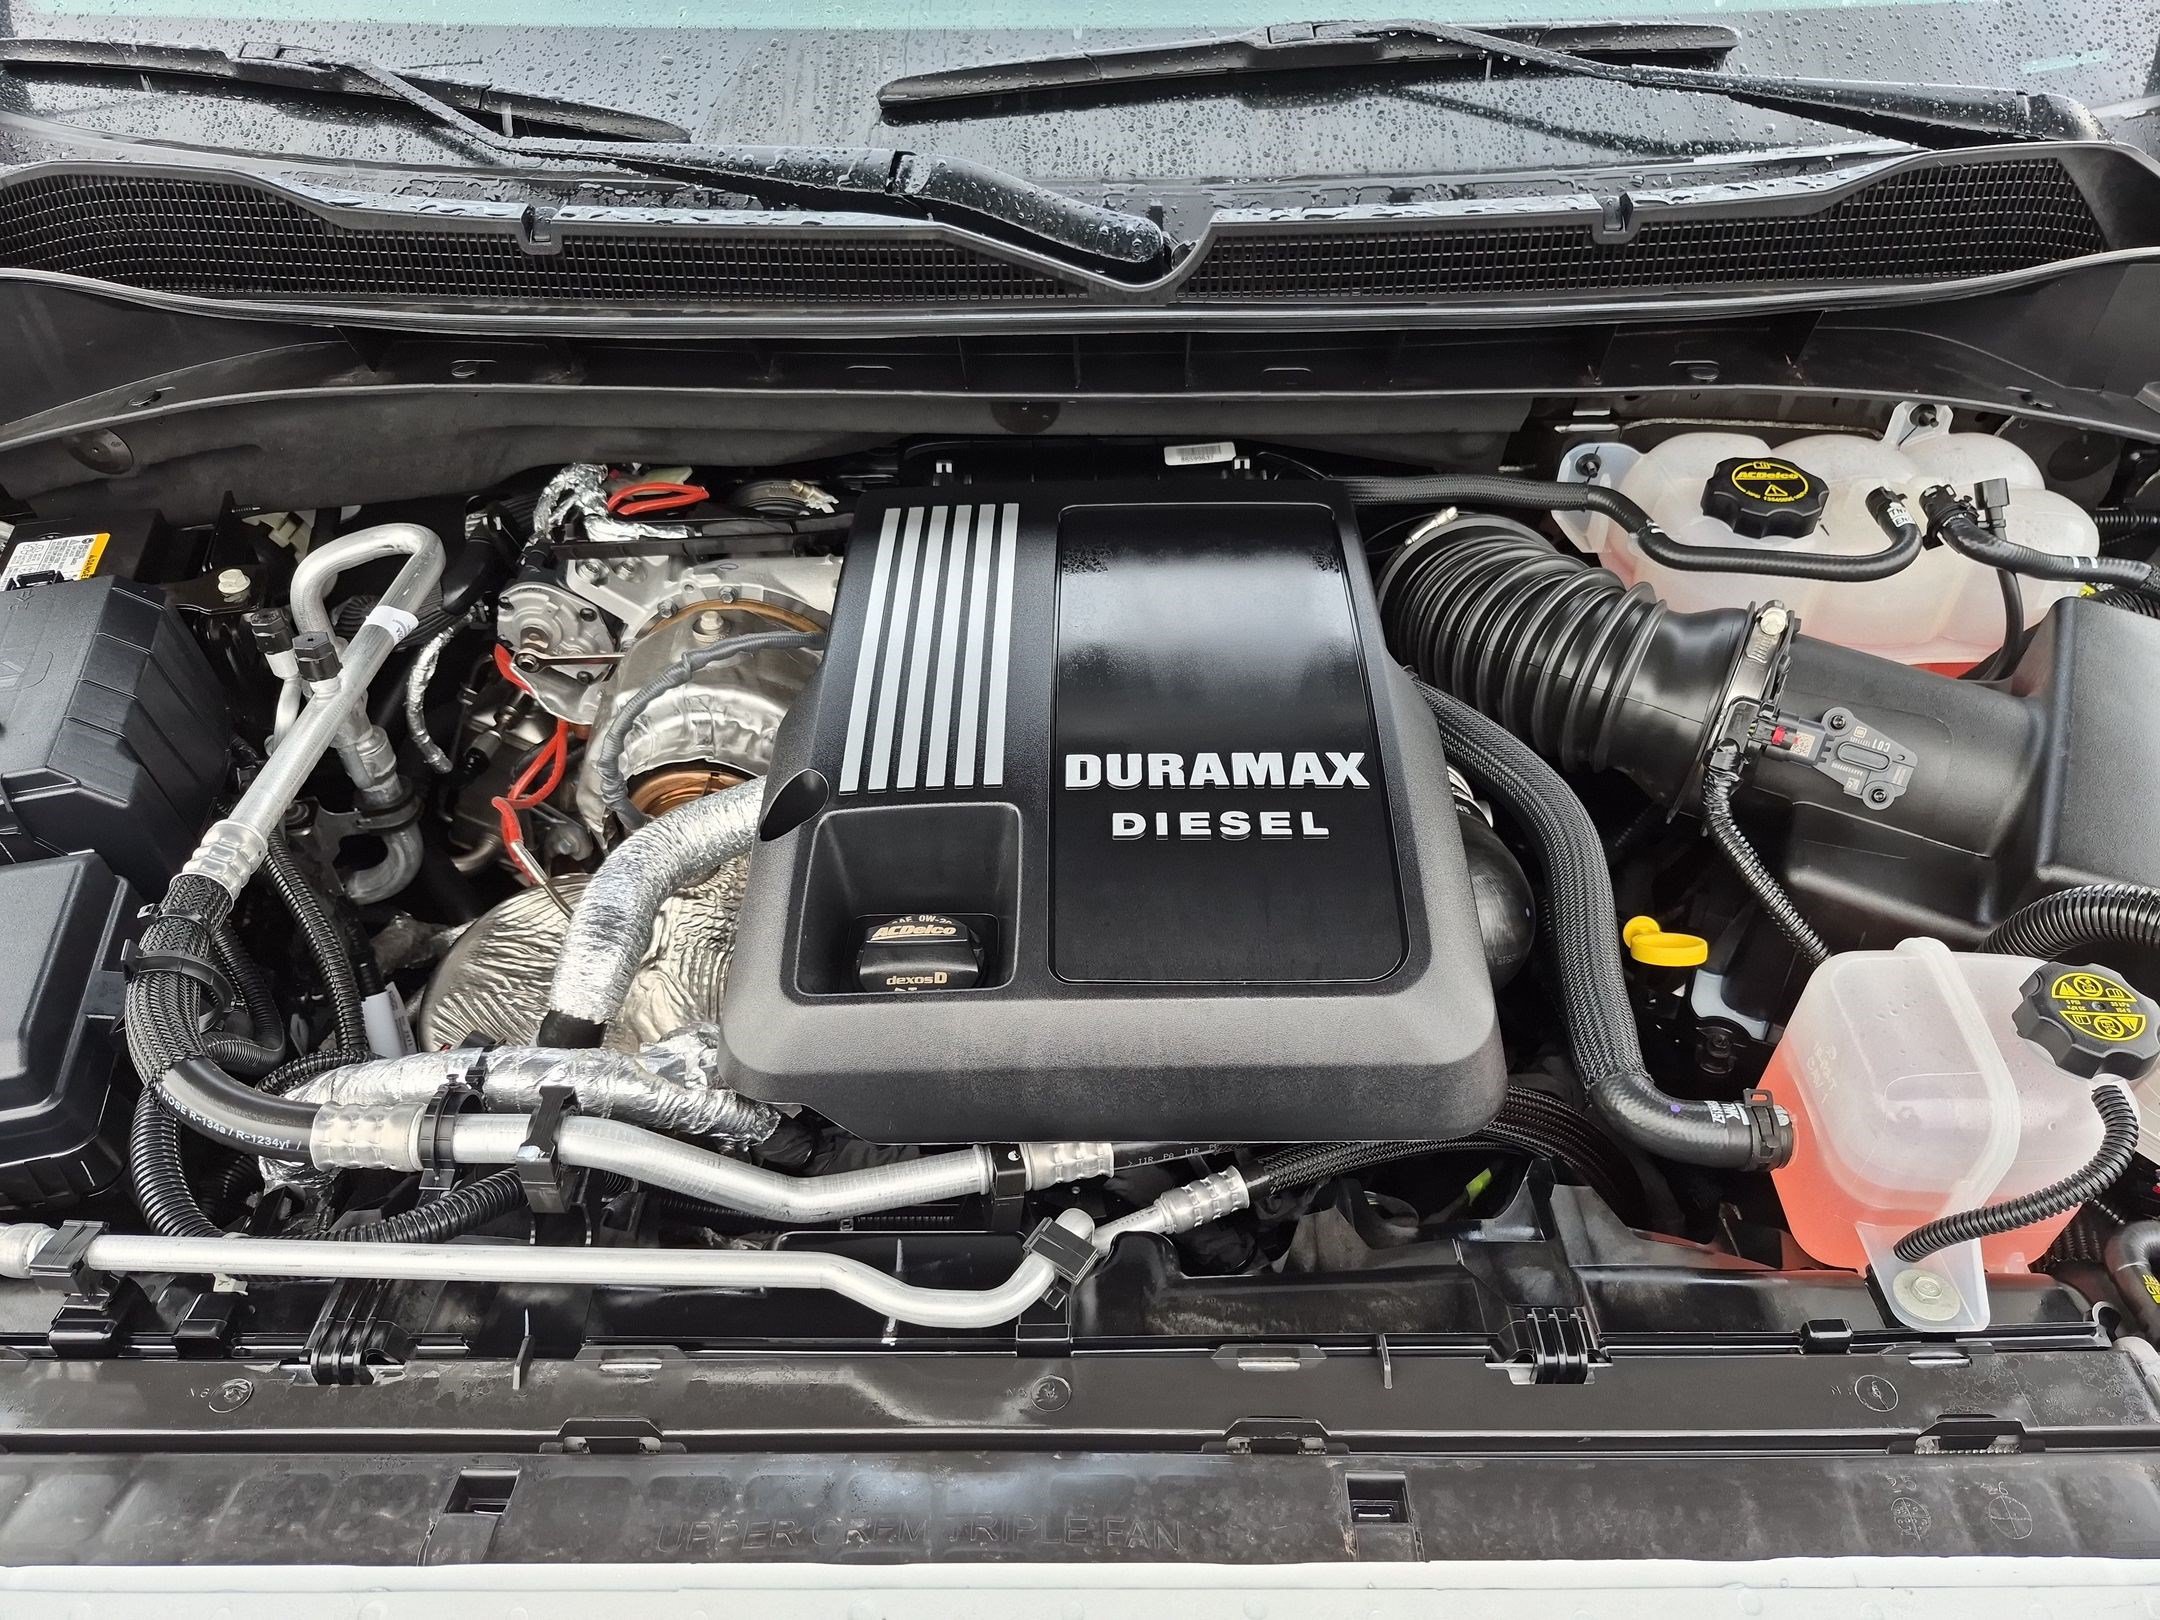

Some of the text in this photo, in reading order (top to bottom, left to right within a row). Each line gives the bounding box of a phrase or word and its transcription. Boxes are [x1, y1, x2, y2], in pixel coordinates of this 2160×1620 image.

[1065, 752, 1370, 790] DURAMAX
[1111, 811, 1330, 840] DIESEL
[871, 924, 958, 938] ACDelco
[886, 972, 948, 985] dexosD
[162, 1090, 188, 1115] HOSE
[189, 1110, 226, 1135] R-134a
[235, 1131, 291, 1150] R-1234yf
[656, 1518, 799, 1553] UPPER
[944, 1513, 1088, 1545] TRIPLE
[1102, 1515, 1181, 1551] FAN
